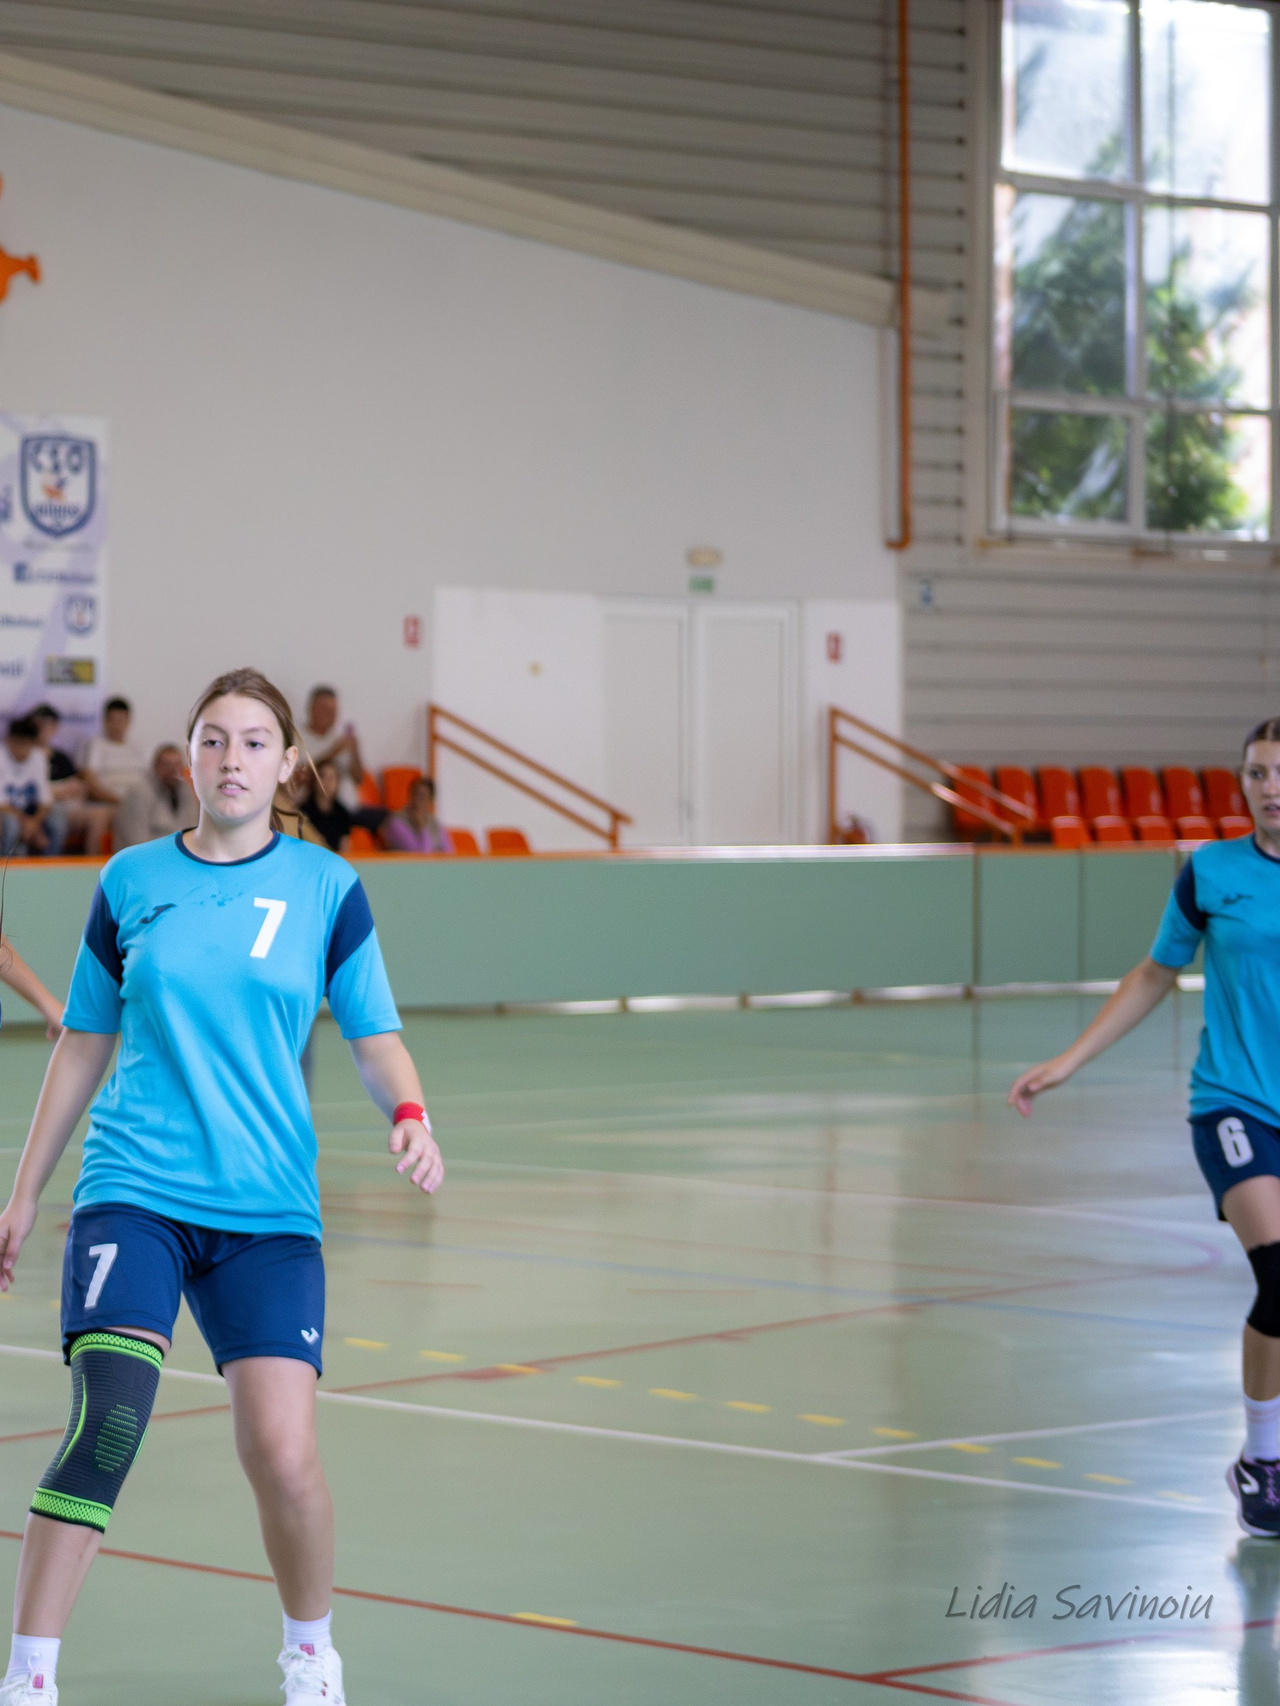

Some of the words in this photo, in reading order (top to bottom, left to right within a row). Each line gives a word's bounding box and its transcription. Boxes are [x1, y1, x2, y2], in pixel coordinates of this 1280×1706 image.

[250, 897, 287, 958] 7
[1216, 1116, 1254, 1168] 6
[84, 1243, 119, 1309] 7
